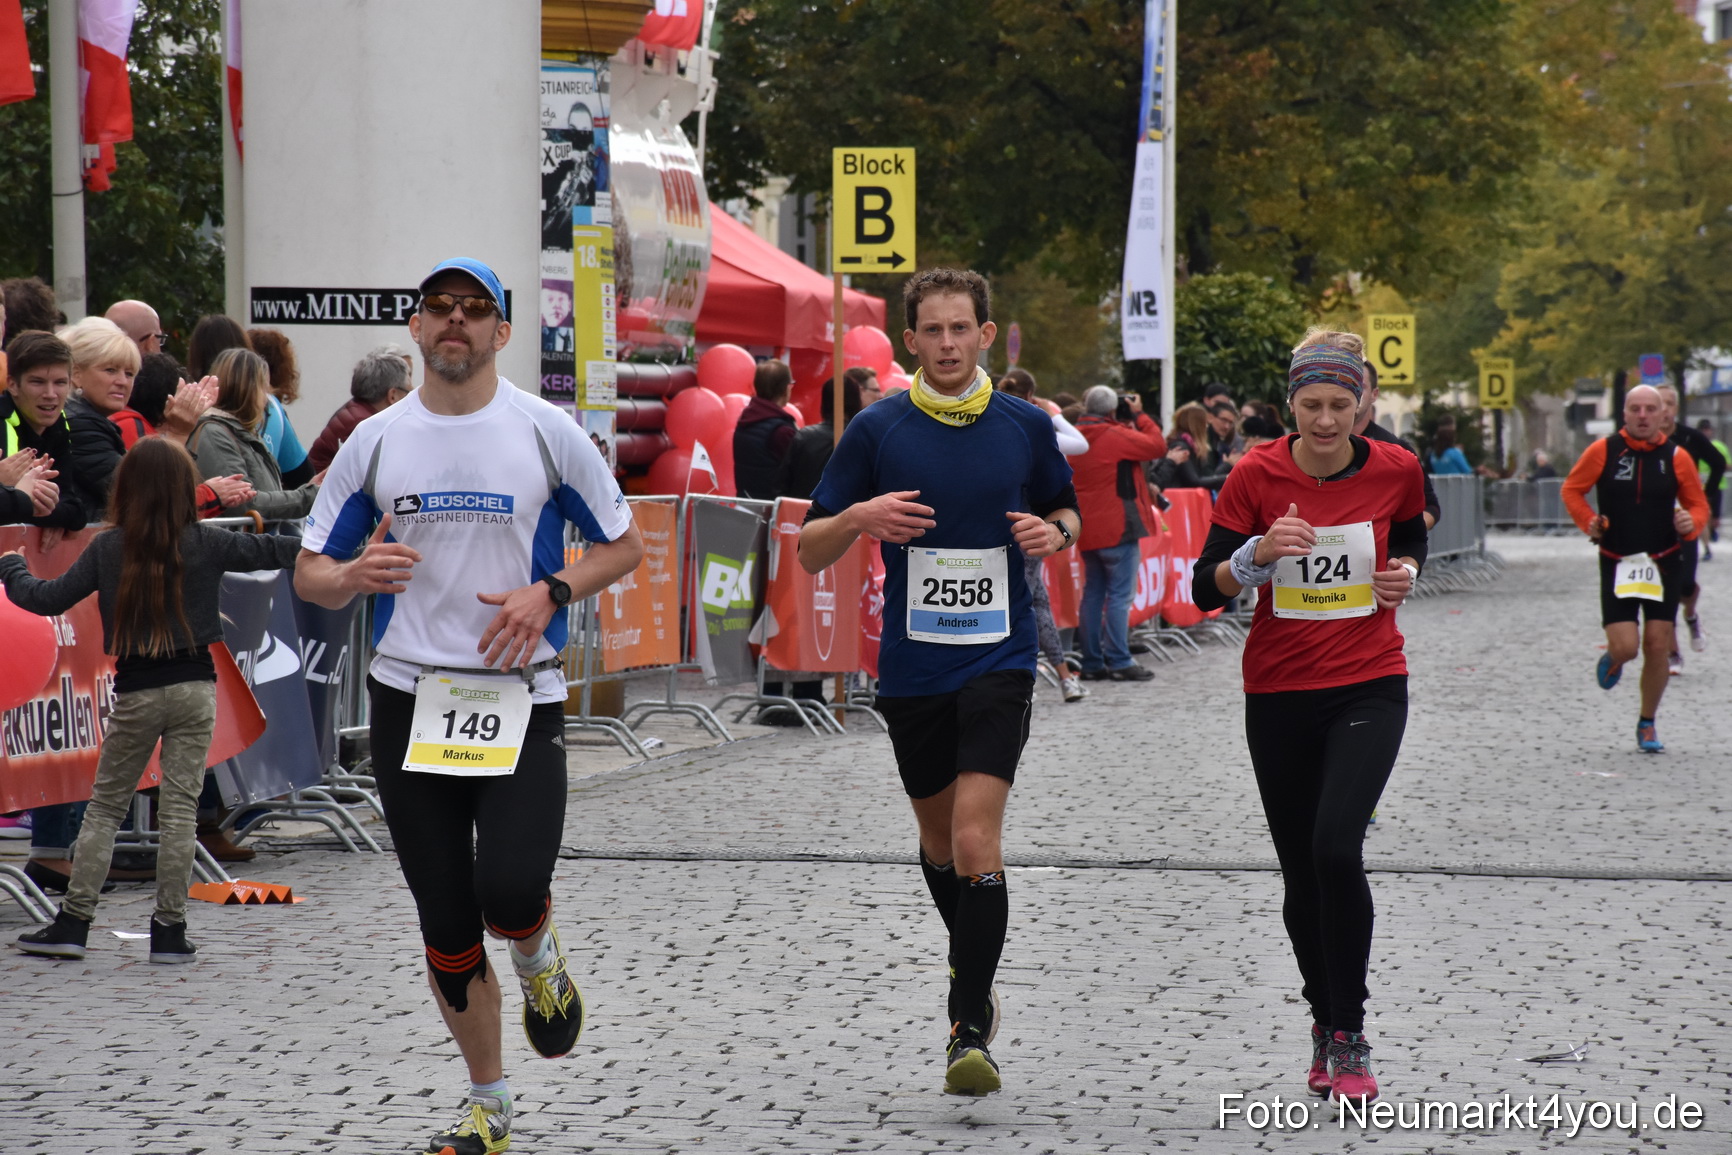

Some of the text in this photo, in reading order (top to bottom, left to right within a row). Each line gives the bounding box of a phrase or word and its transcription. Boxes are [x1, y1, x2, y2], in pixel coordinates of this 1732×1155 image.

[555, 144, 572, 159] CUP
[843, 153, 906, 175] Block
[855, 186, 895, 245] B
[577, 244, 601, 269] 18.
[252, 293, 421, 321] www.MINI-P
[1373, 318, 1409, 330] Block
[1379, 335, 1402, 369] C
[540, 373, 577, 391] KER
[1488, 373, 1505, 397] D
[427, 494, 508, 511] BÜSCHEL
[397, 512, 513, 526] FEINSCHNEIDTEAM
[947, 558, 983, 567] BOCK
[1295, 554, 1351, 584] 124
[1628, 566, 1654, 581] 410
[922, 577, 993, 607] 2558
[1302, 592, 1346, 604] Veronika
[937, 616, 979, 628] Andreas
[460, 688, 500, 700] BOCK
[3, 675, 97, 757] aktuellen
[442, 709, 502, 742] 149
[442, 749, 485, 761] Markus
